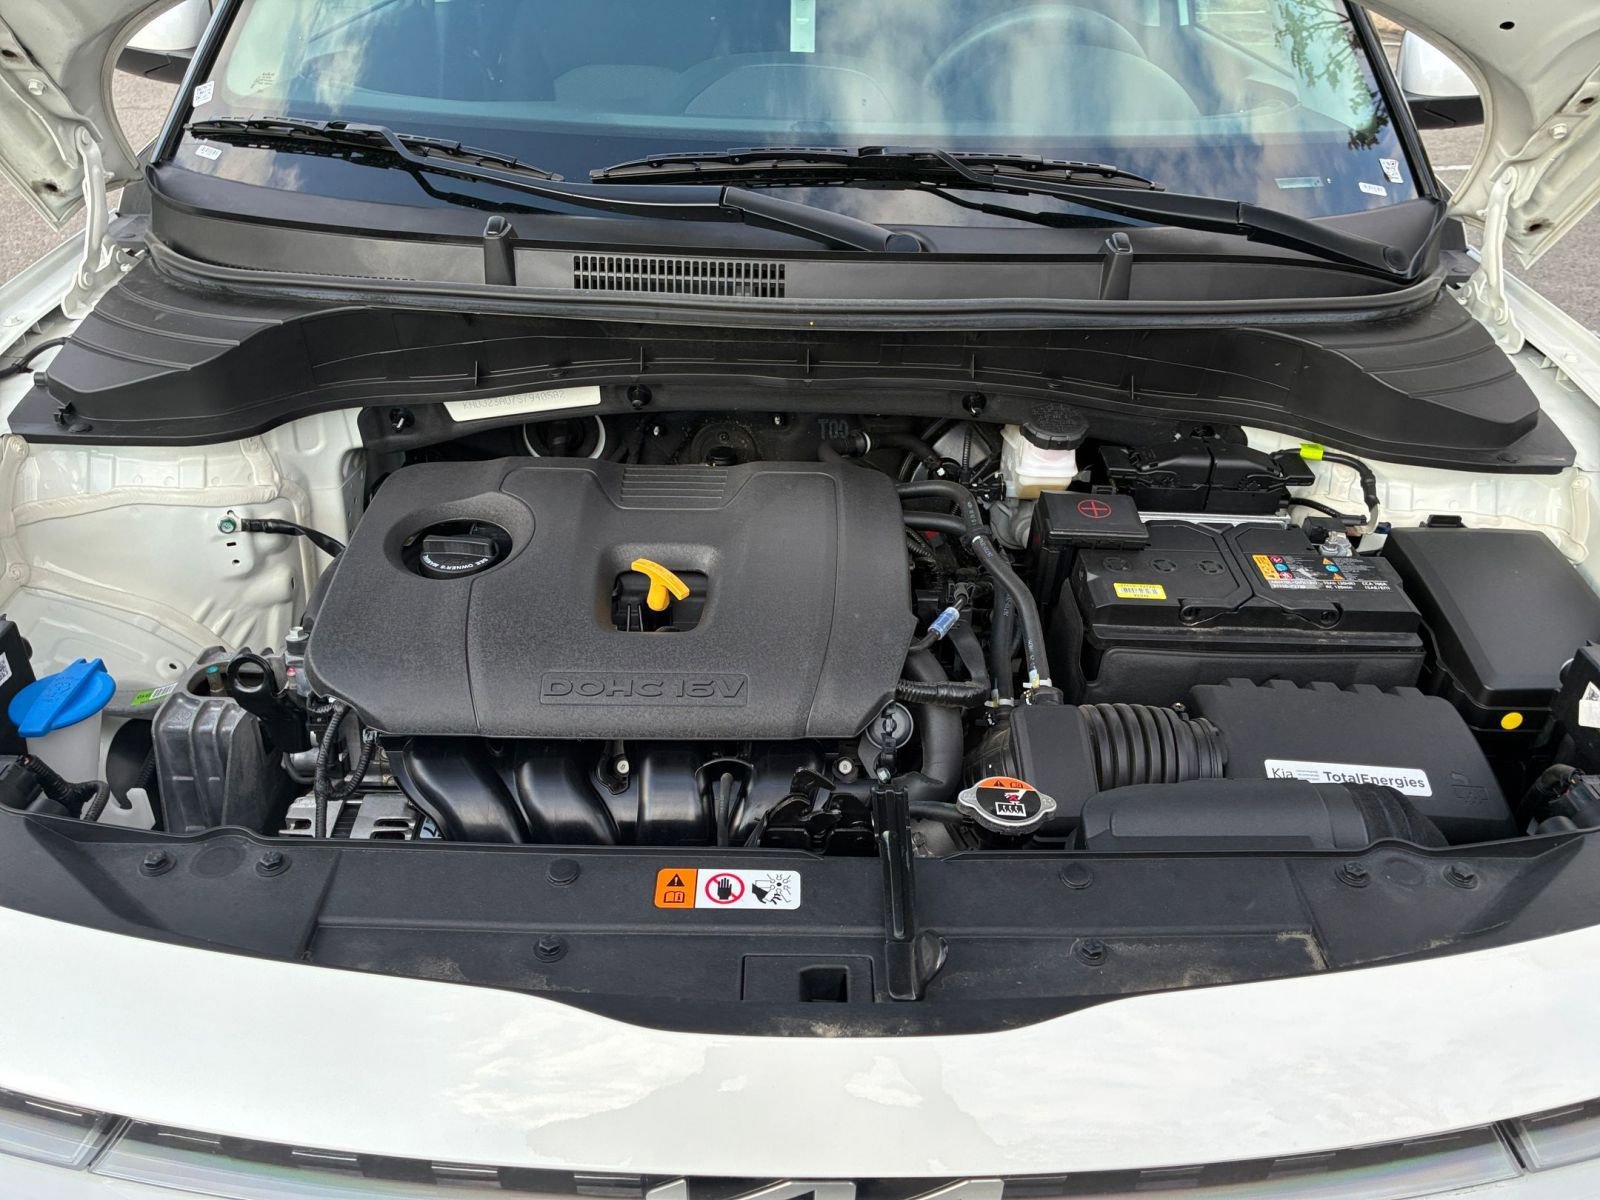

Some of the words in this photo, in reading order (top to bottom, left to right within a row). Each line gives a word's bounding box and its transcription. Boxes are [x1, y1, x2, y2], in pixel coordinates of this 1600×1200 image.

[543, 678, 665, 698] DOHC
[674, 679, 746, 699] 16V
[1271, 767, 1294, 779] Kia
[1322, 770, 1426, 789] TotalEnergies
